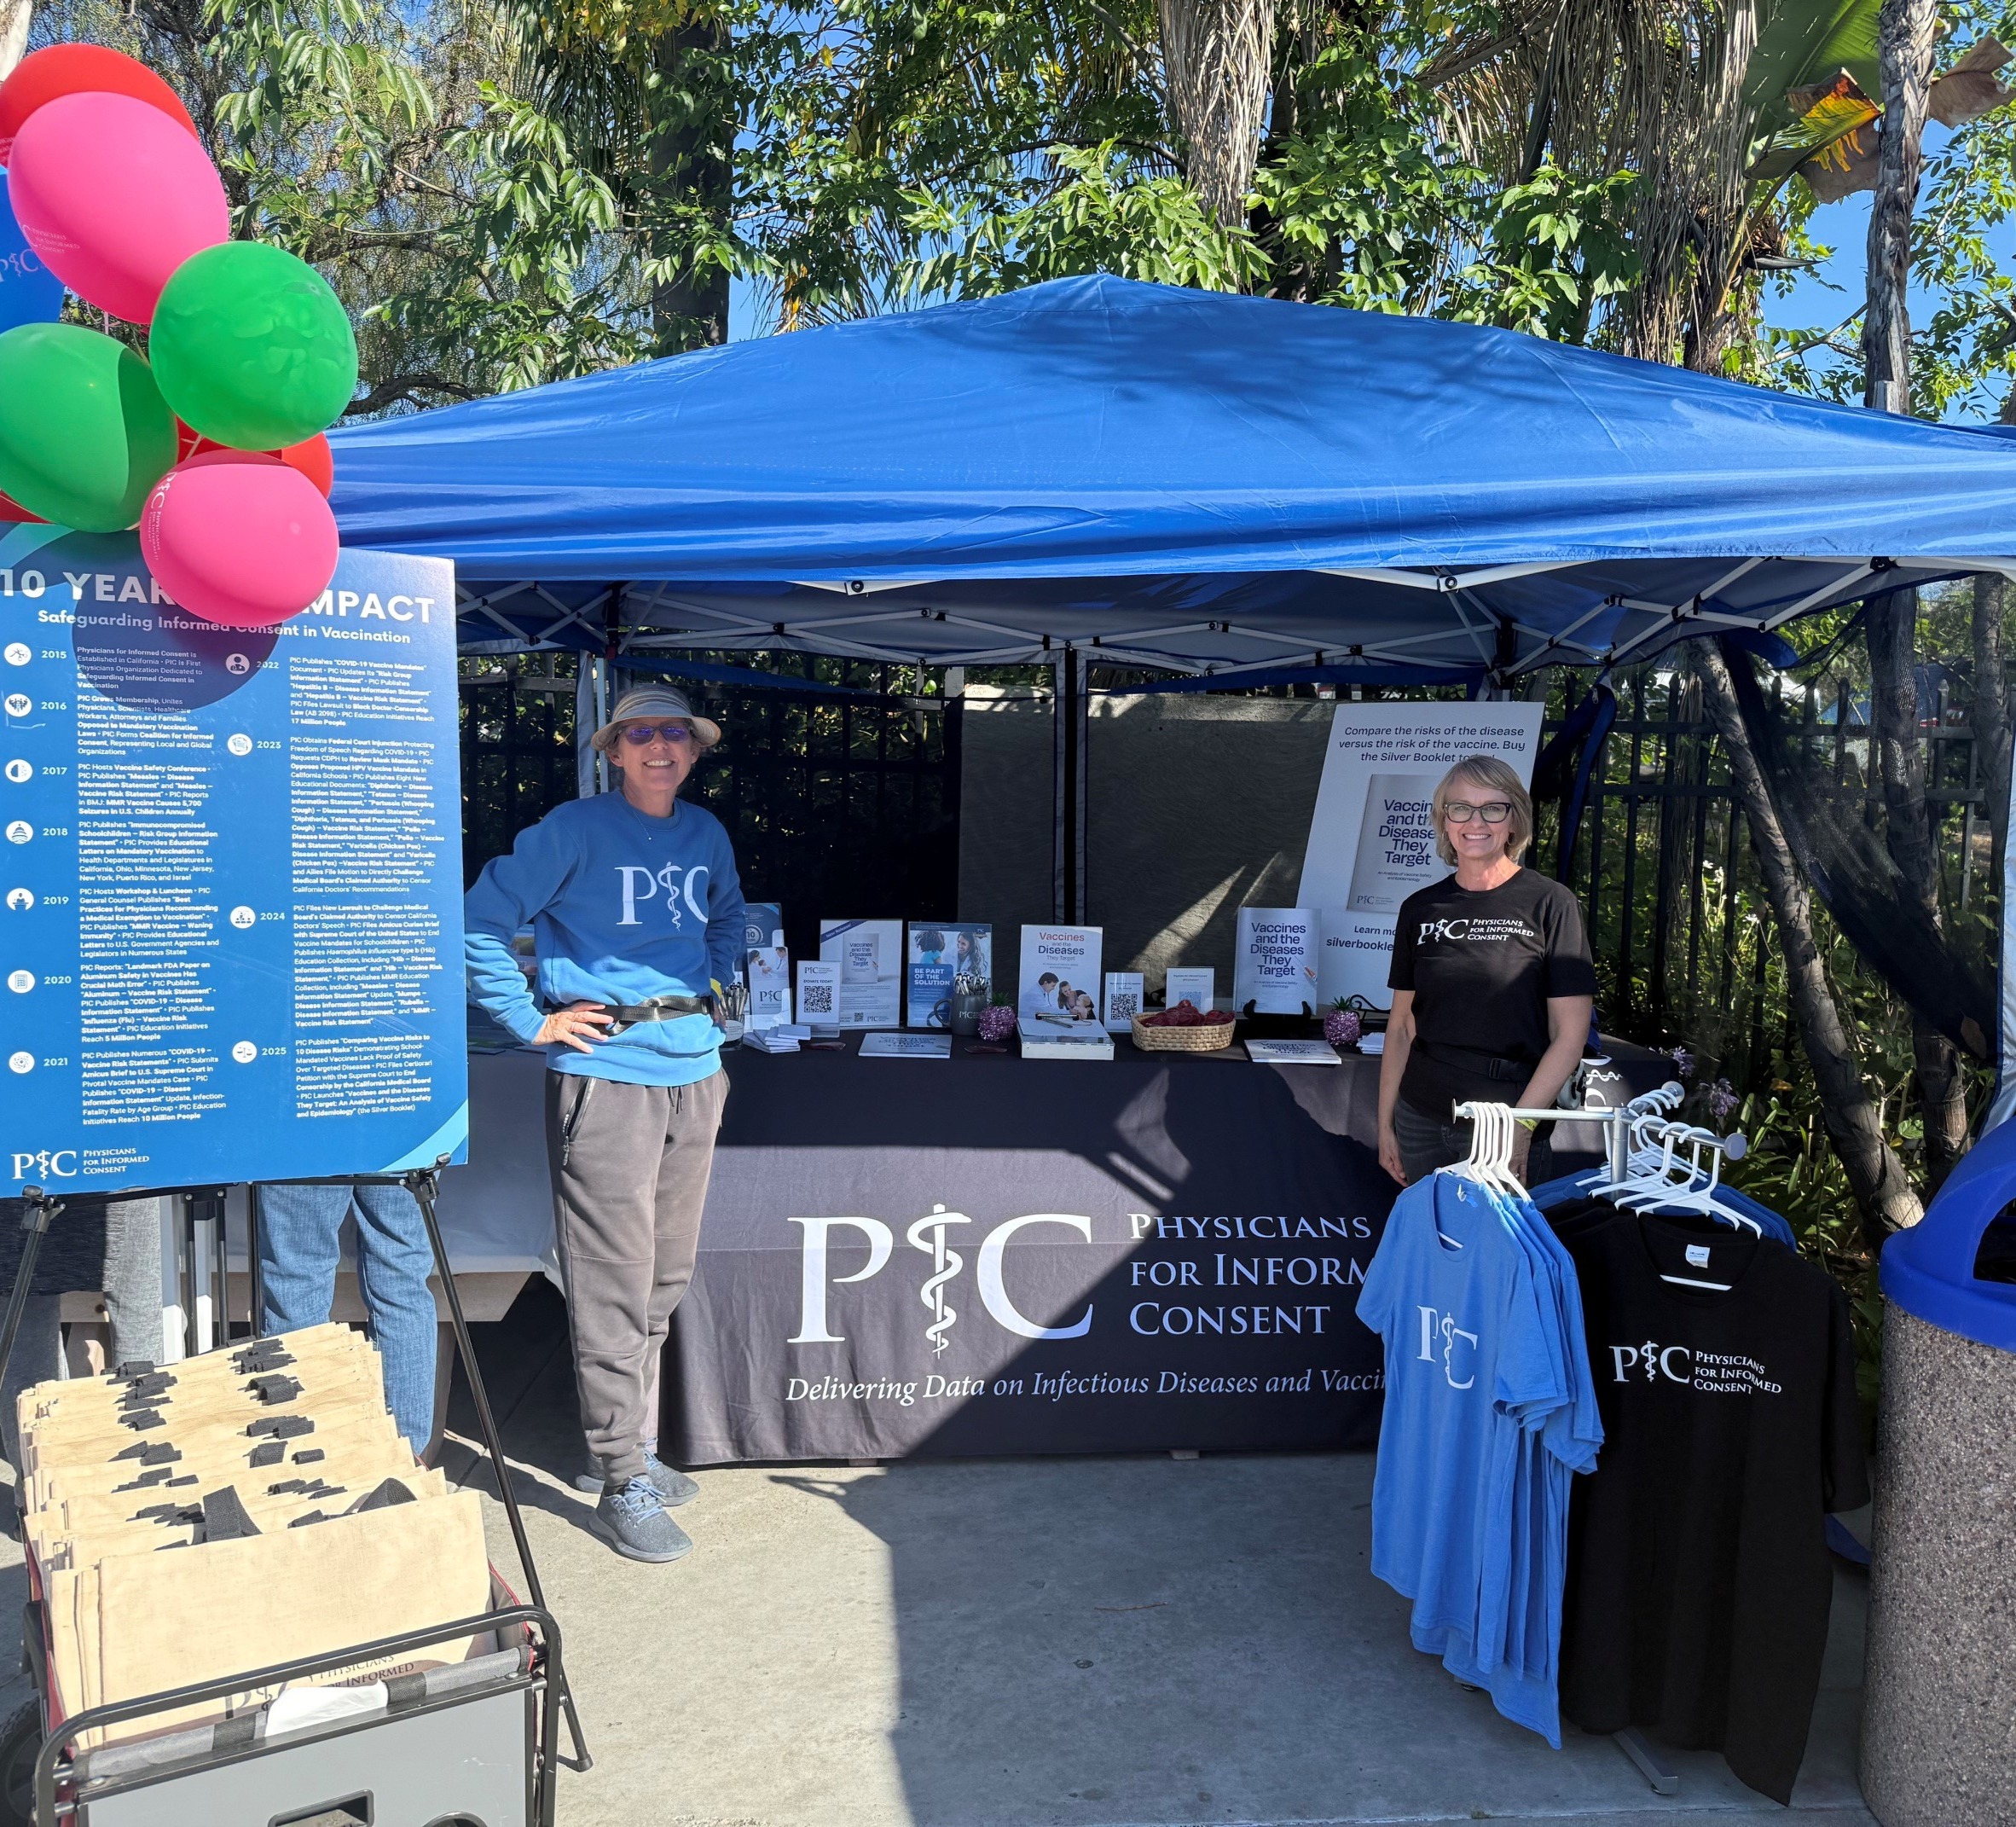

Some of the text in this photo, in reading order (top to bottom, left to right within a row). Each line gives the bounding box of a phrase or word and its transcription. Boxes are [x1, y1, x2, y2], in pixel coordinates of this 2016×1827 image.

[0, 569, 45, 598] 10
[301, 589, 435, 624] MPACT
[38, 610, 153, 631] Safeguarding
[158, 617, 230, 632] Informed
[304, 625, 317, 637] in
[321, 626, 410, 644] Vaccination
[41, 650, 67, 658] 2015
[77, 647, 115, 655] Physicians
[41, 702, 67, 710] 2016
[1345, 727, 1392, 737] Compare
[1415, 727, 1441, 735] risks
[1444, 727, 1456, 735] of
[1458, 727, 1477, 735] the
[1480, 727, 1524, 736] disease
[1376, 740, 1393, 748] the
[1396, 740, 1416, 748] risk
[1418, 740, 1430, 748] of
[1433, 740, 1451, 749] the
[1454, 740, 1499, 750] vaccine.
[1503, 741, 1526, 751] Buy
[1381, 752, 1411, 762] Silver
[1414, 753, 1456, 762] Booklet
[43, 767, 67, 775] 2017
[1384, 799, 1434, 812] Vaccin
[1387, 813, 1432, 826] and th
[1379, 826, 1436, 839] Disease
[1392, 838, 1428, 854] They
[1385, 851, 1432, 867] Target
[43, 896, 69, 905] 2019
[1251, 922, 1306, 933] Vaccines
[1354, 925, 1396, 936] Learn mo
[1486, 926, 1534, 937] INFORMED
[1040, 932, 1085, 942] Vaccines
[1255, 934, 1301, 944] and the
[1039, 945, 1085, 954] Diseases
[1250, 944, 1304, 954] Diseases
[1326, 937, 1394, 951] silverbookle
[1262, 954, 1292, 966] They
[1257, 965, 1295, 977] Target
[43, 976, 72, 984] 2020
[43, 1058, 68, 1066] 2021
[84, 1116, 117, 1125] Initiatives
[84, 1148, 136, 1157] PHYSICIANS
[101, 1156, 149, 1165] INFORMED
[84, 1166, 127, 1174] CONSENT
[1127, 1213, 1372, 1239] PHYSICIANS
[1130, 1253, 1375, 1286] FOR INFORM
[1129, 1302, 1330, 1336] CONSENT
[1695, 1351, 1765, 1374] PHYSICIANS
[1694, 1366, 1782, 1394] FOR INFORMED
[785, 1376, 918, 1406] Delivering
[923, 1374, 986, 1398] Data
[994, 1380, 1023, 1395] on
[1031, 1370, 1150, 1402] Infectious
[1156, 1371, 1258, 1394] Diseases
[1266, 1368, 1312, 1393] and
[1694, 1379, 1752, 1395] CONSENT
[346, 1662, 414, 1686] INFORMED
